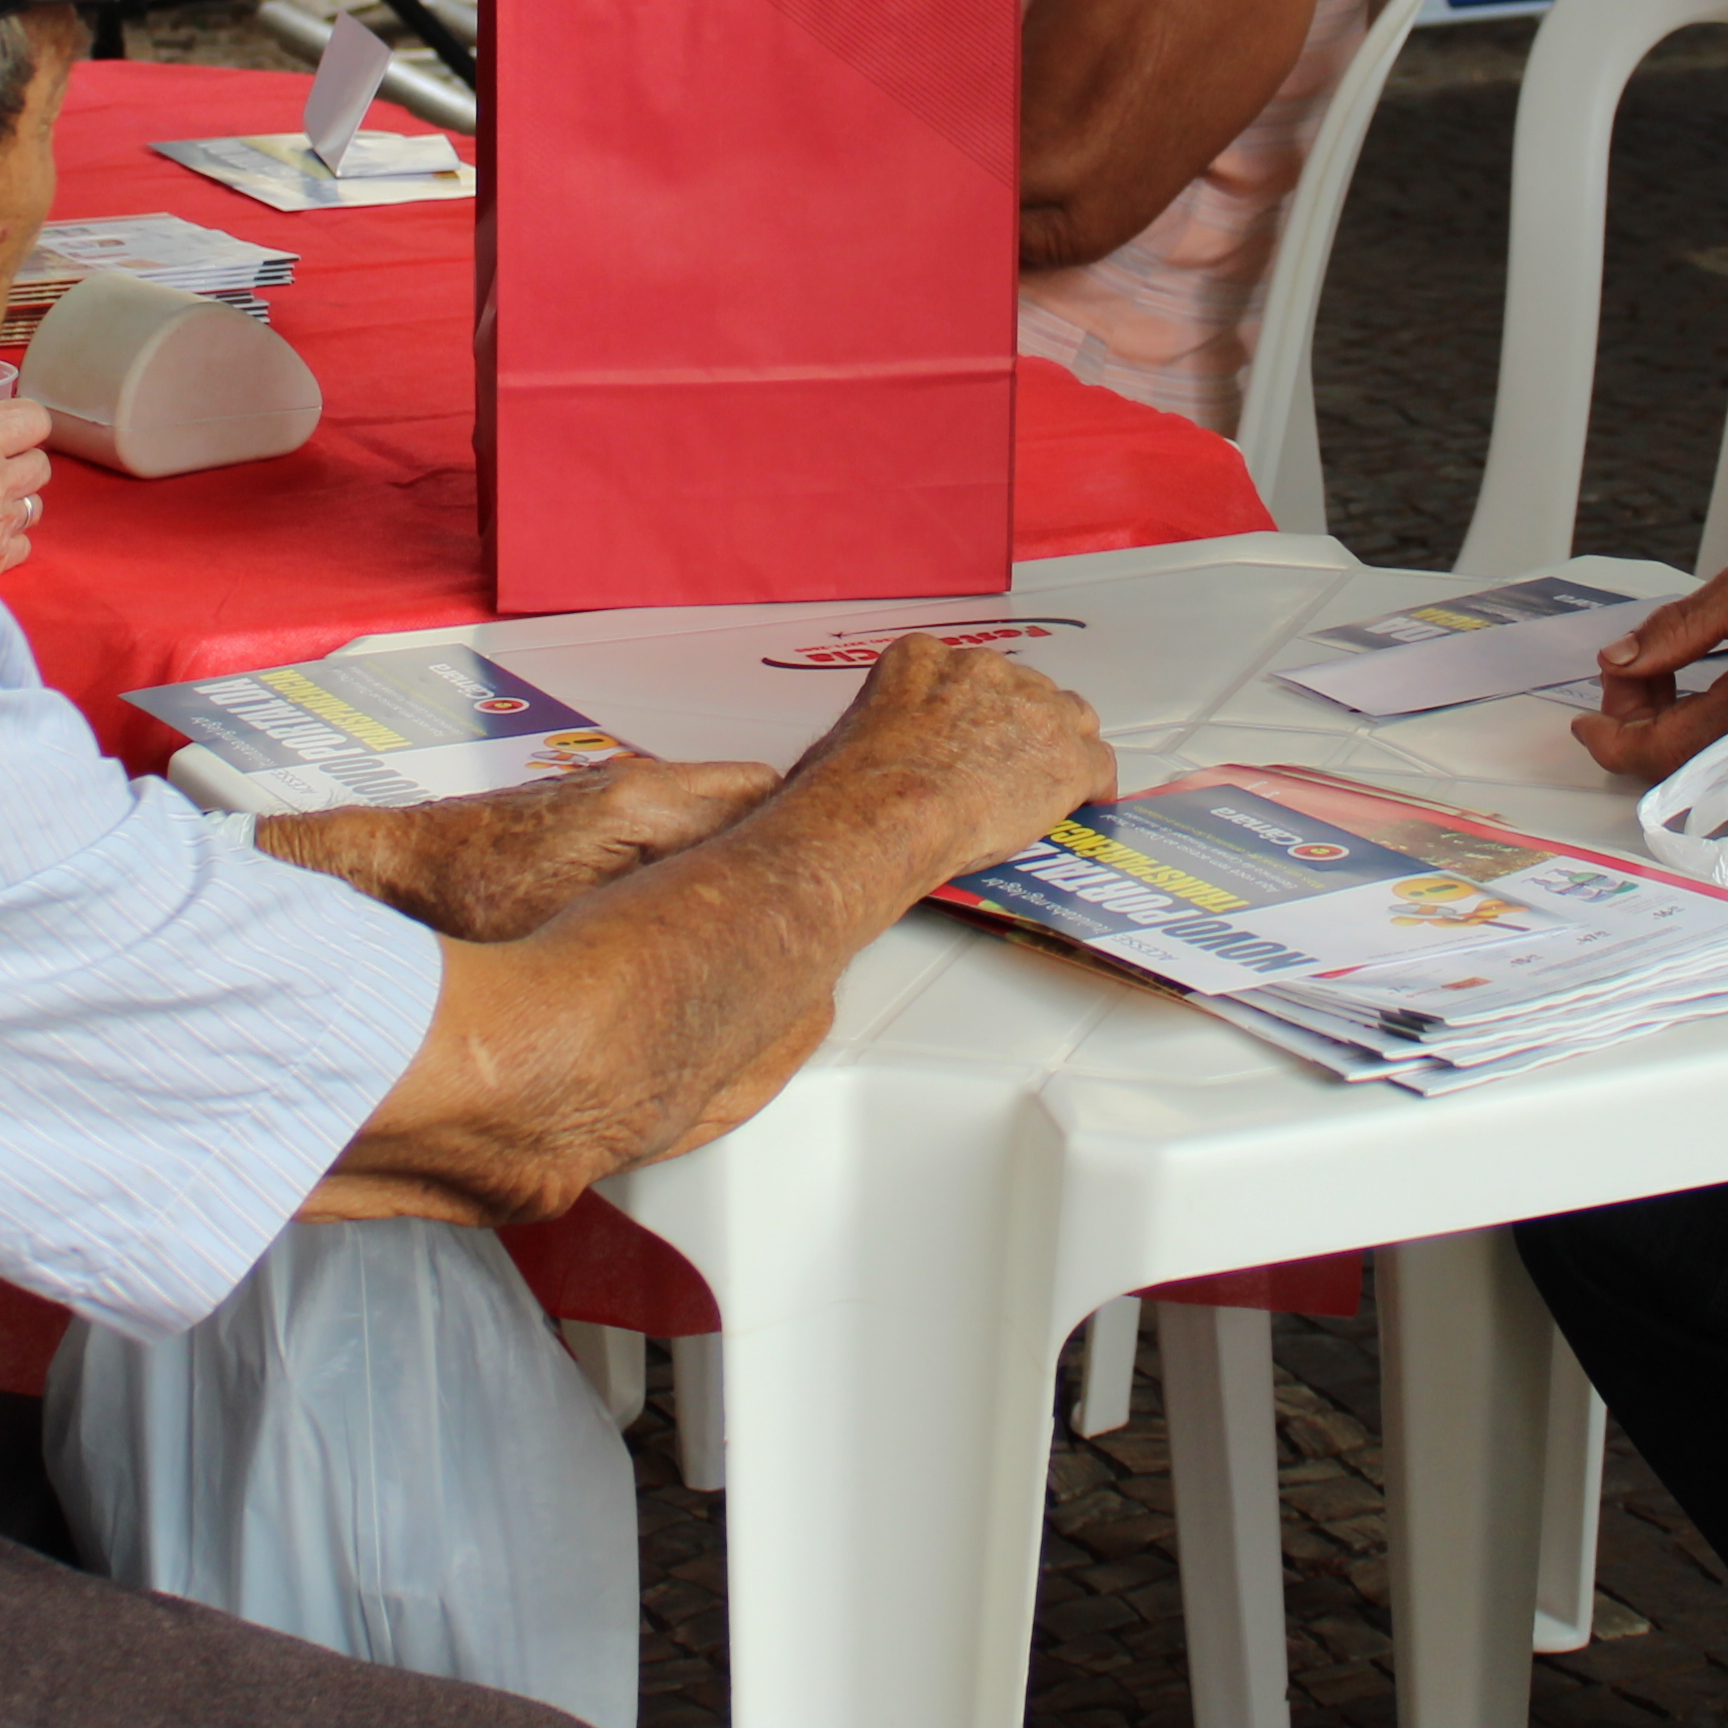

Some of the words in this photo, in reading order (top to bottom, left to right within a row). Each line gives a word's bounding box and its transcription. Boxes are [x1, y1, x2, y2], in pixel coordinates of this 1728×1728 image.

[1210, 806, 1303, 847] Câmara
[1047, 819, 1250, 914] TRANSPARÊNCI
[1161, 920, 1320, 975] NOVO
